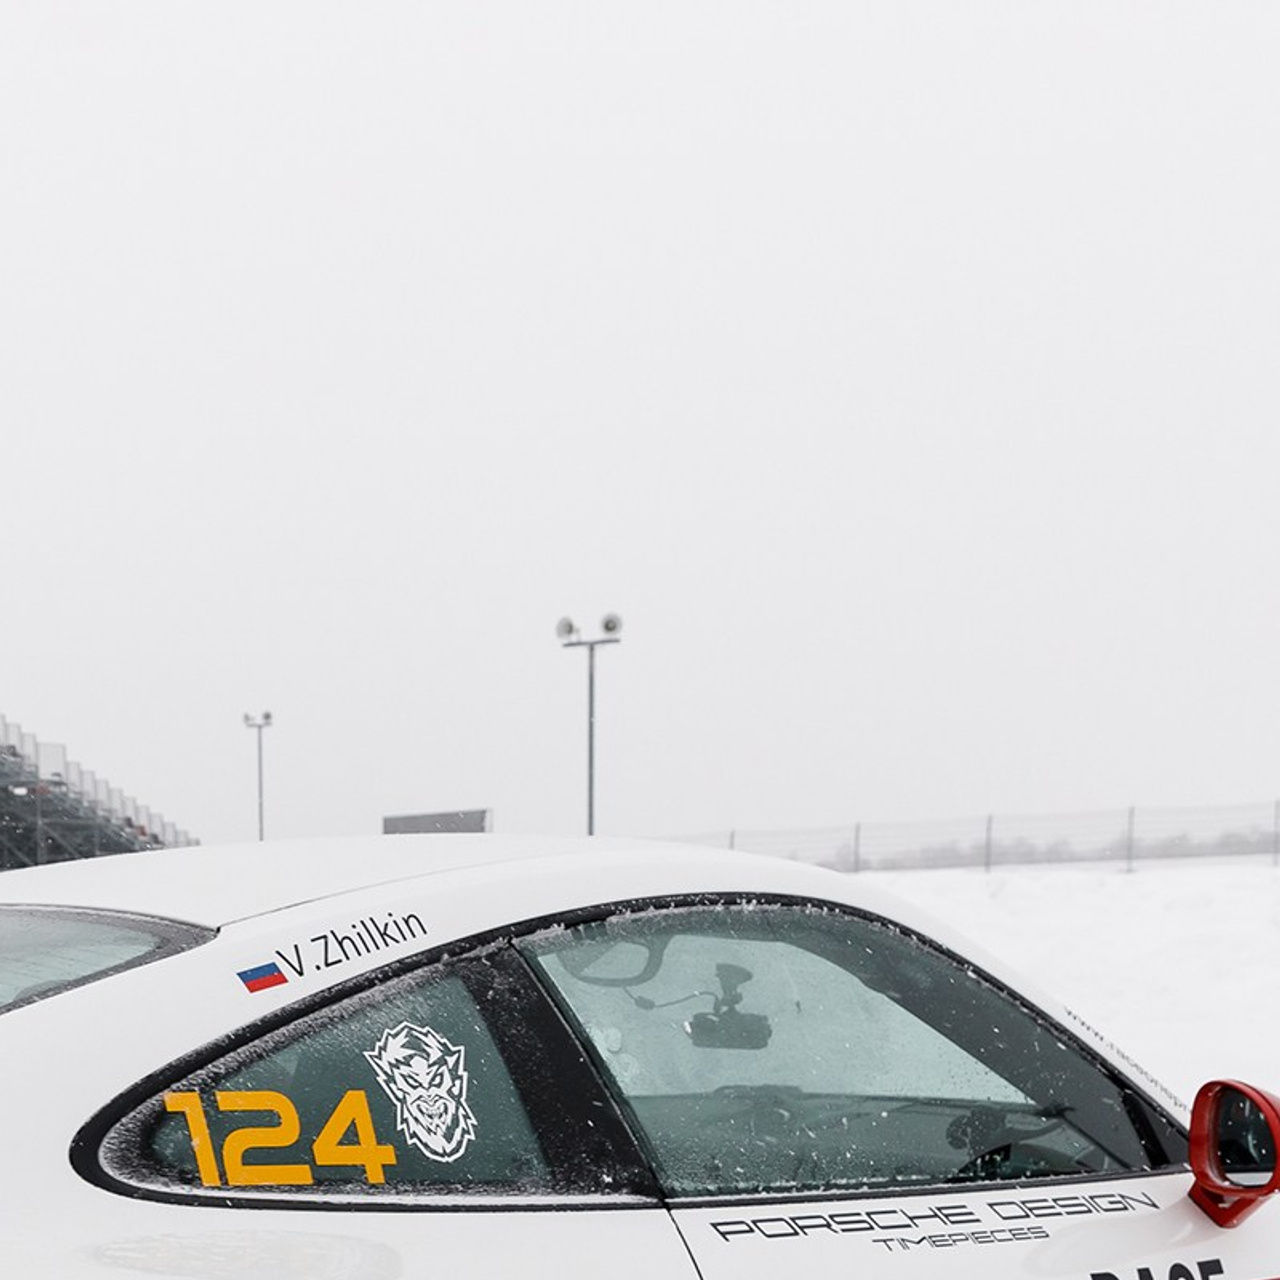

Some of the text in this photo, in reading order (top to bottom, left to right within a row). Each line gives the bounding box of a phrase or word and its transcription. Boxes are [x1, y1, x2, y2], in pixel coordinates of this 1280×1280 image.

[275, 912, 427, 977] V.Zhilkin
[164, 1090, 397, 1186] 124
[709, 1191, 1160, 1243] PORSCHE DESIGN
[871, 1225, 1050, 1252] TIMEPIECES
